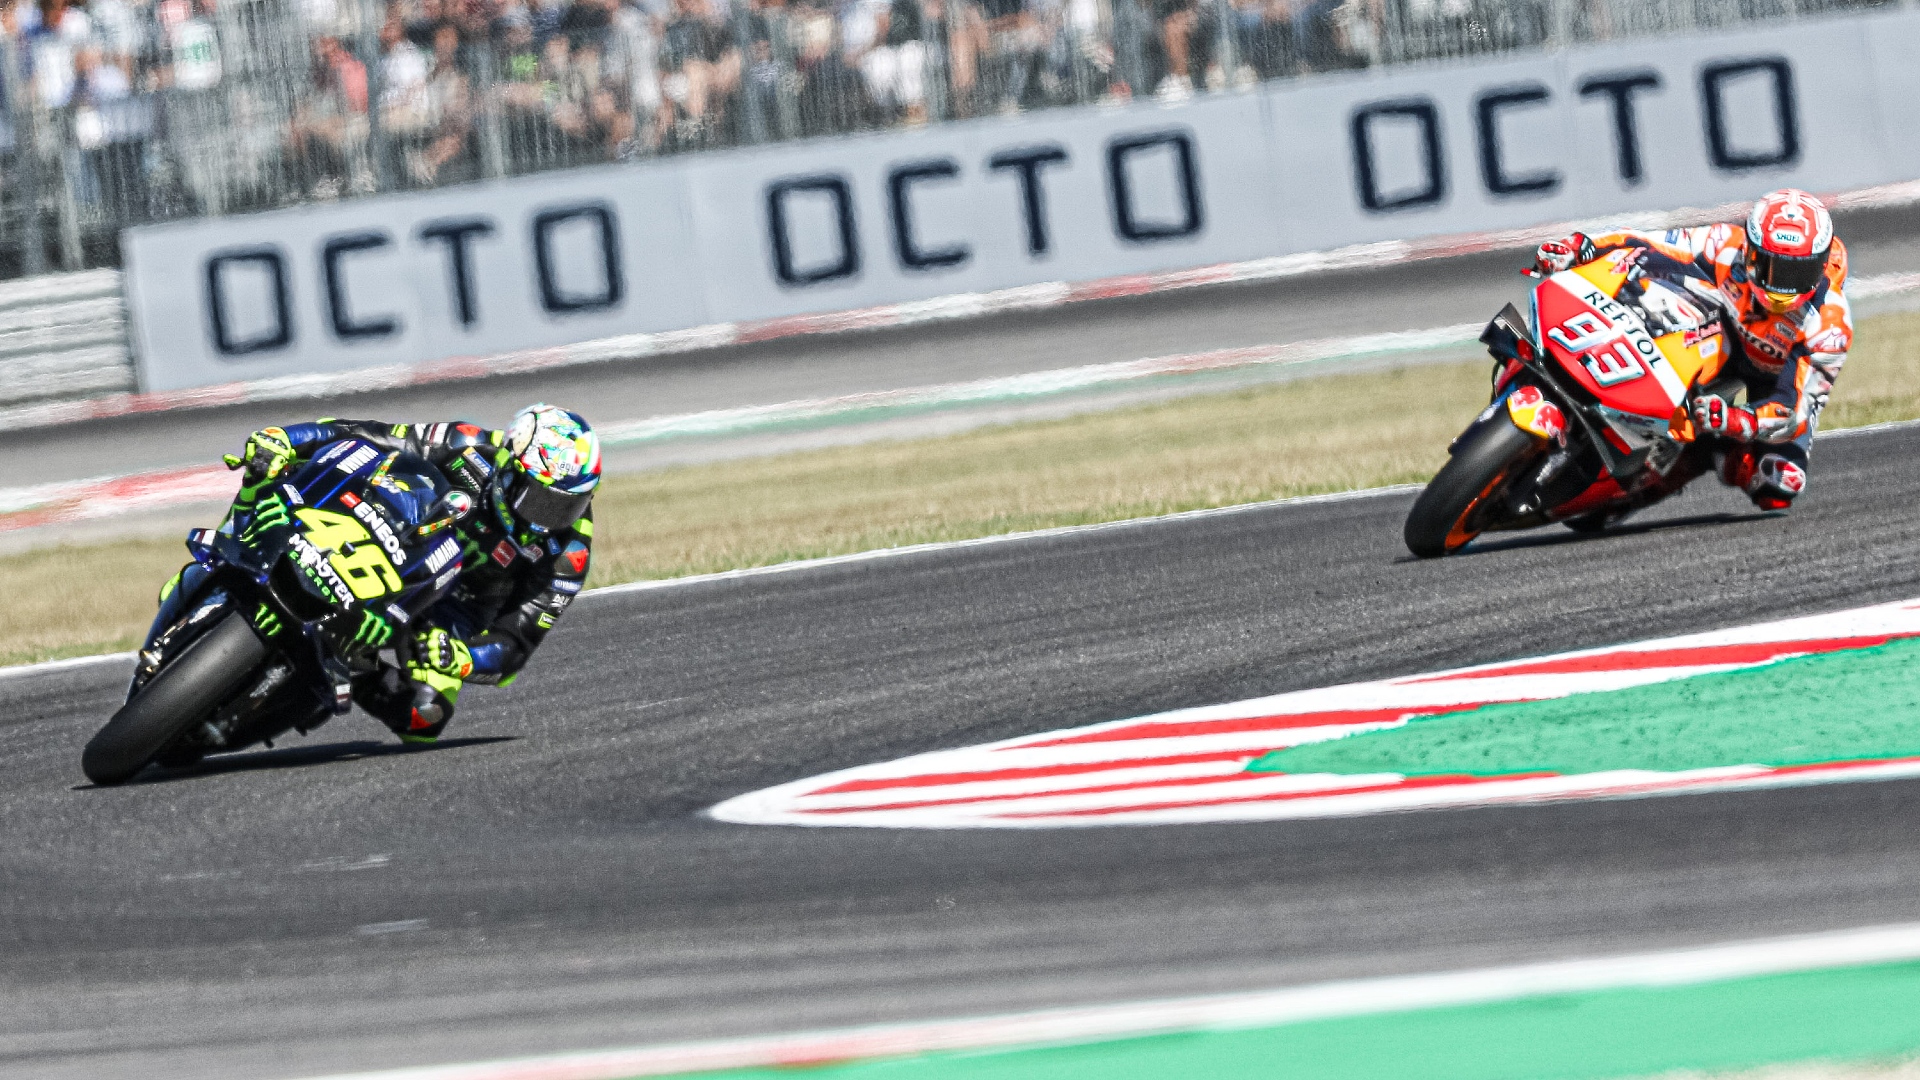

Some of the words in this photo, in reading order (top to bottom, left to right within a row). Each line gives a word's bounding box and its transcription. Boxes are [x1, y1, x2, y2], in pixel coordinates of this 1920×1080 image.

[206, 202, 624, 356] OCTO
[766, 128, 1203, 286] OCTO
[1350, 56, 1802, 212] OCTO
[1547, 311, 1646, 387] 93
[1584, 291, 1662, 369] REPSOL
[294, 507, 404, 600] 46
[353, 501, 407, 566] ENEOS
[425, 537, 460, 574] YAMAHA
